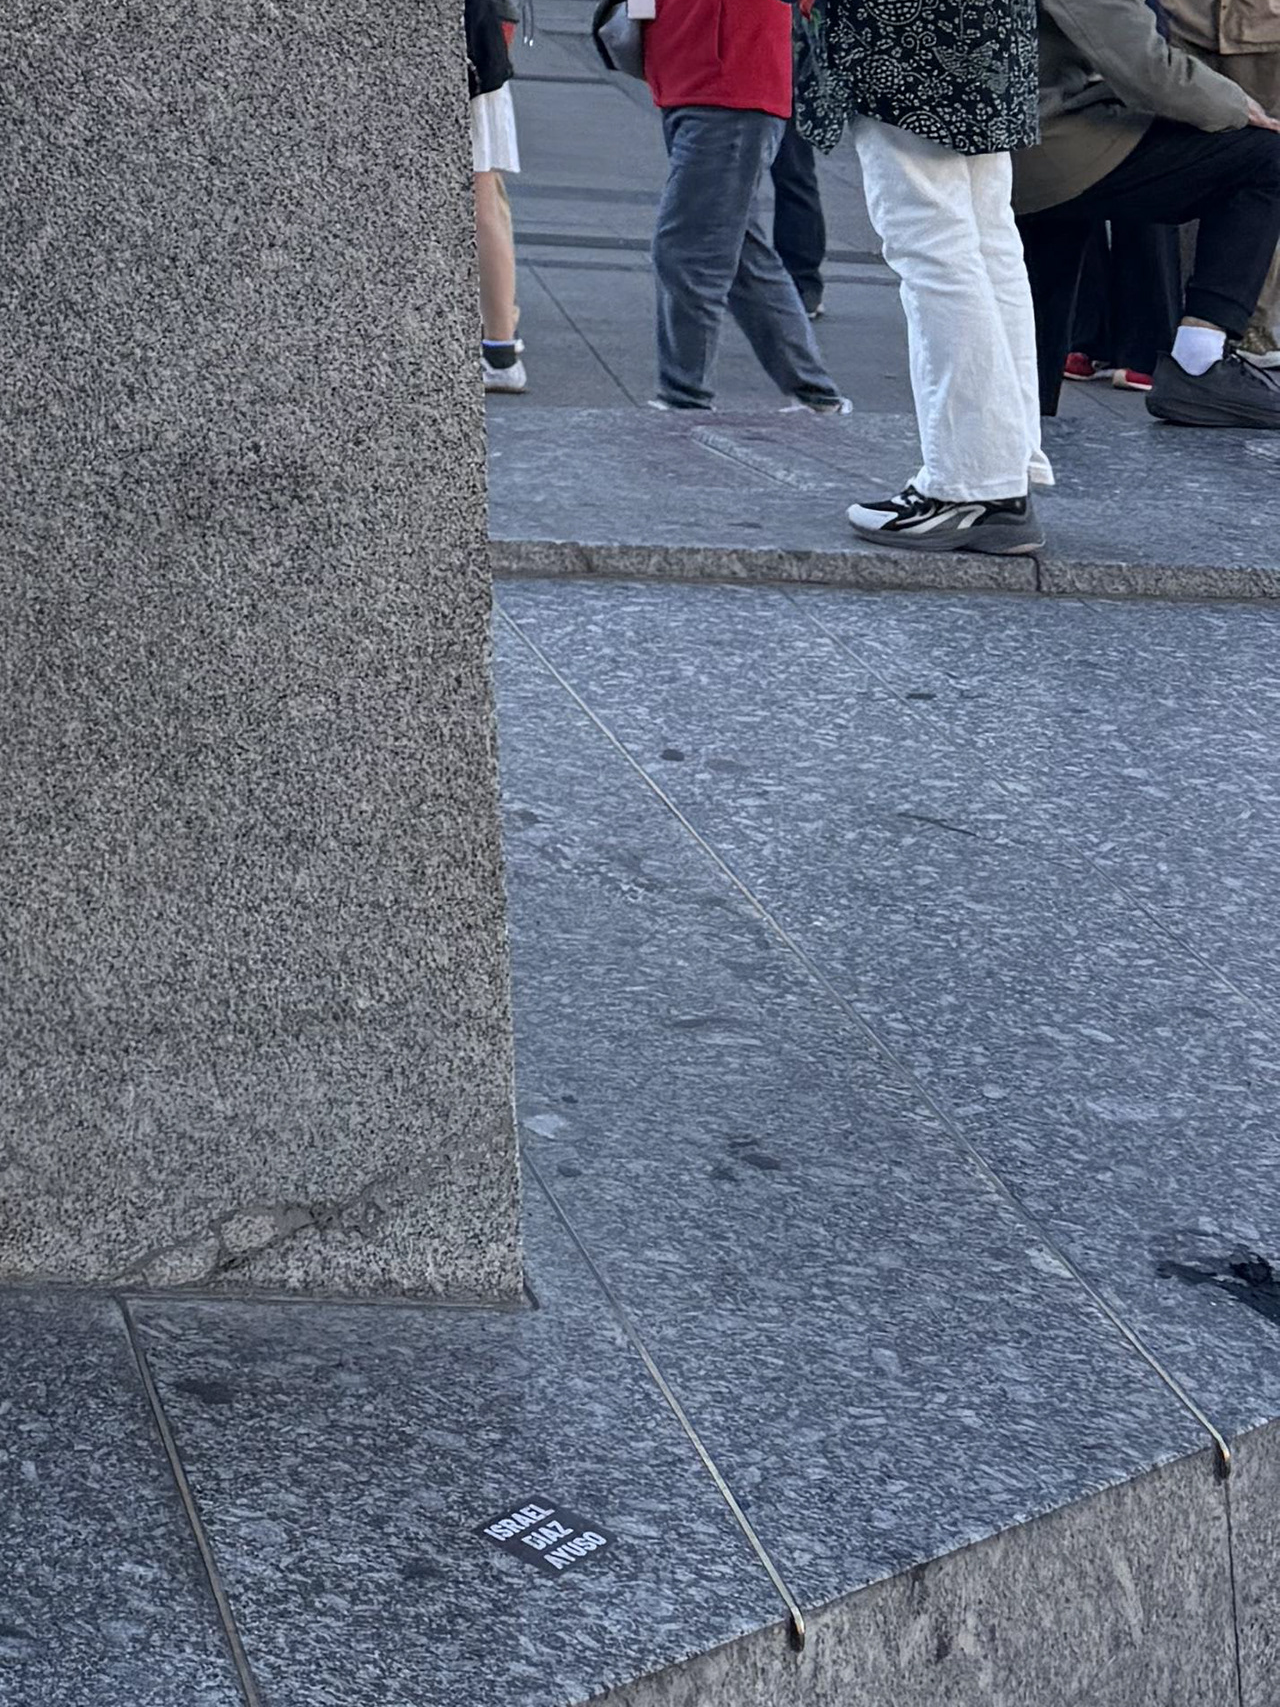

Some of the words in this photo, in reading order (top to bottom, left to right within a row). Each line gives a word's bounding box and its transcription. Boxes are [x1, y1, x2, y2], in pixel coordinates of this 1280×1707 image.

[483, 1503, 555, 1542] ISRAEL
[521, 1520, 574, 1550] DIAZ
[543, 1531, 607, 1570] AYUSO
